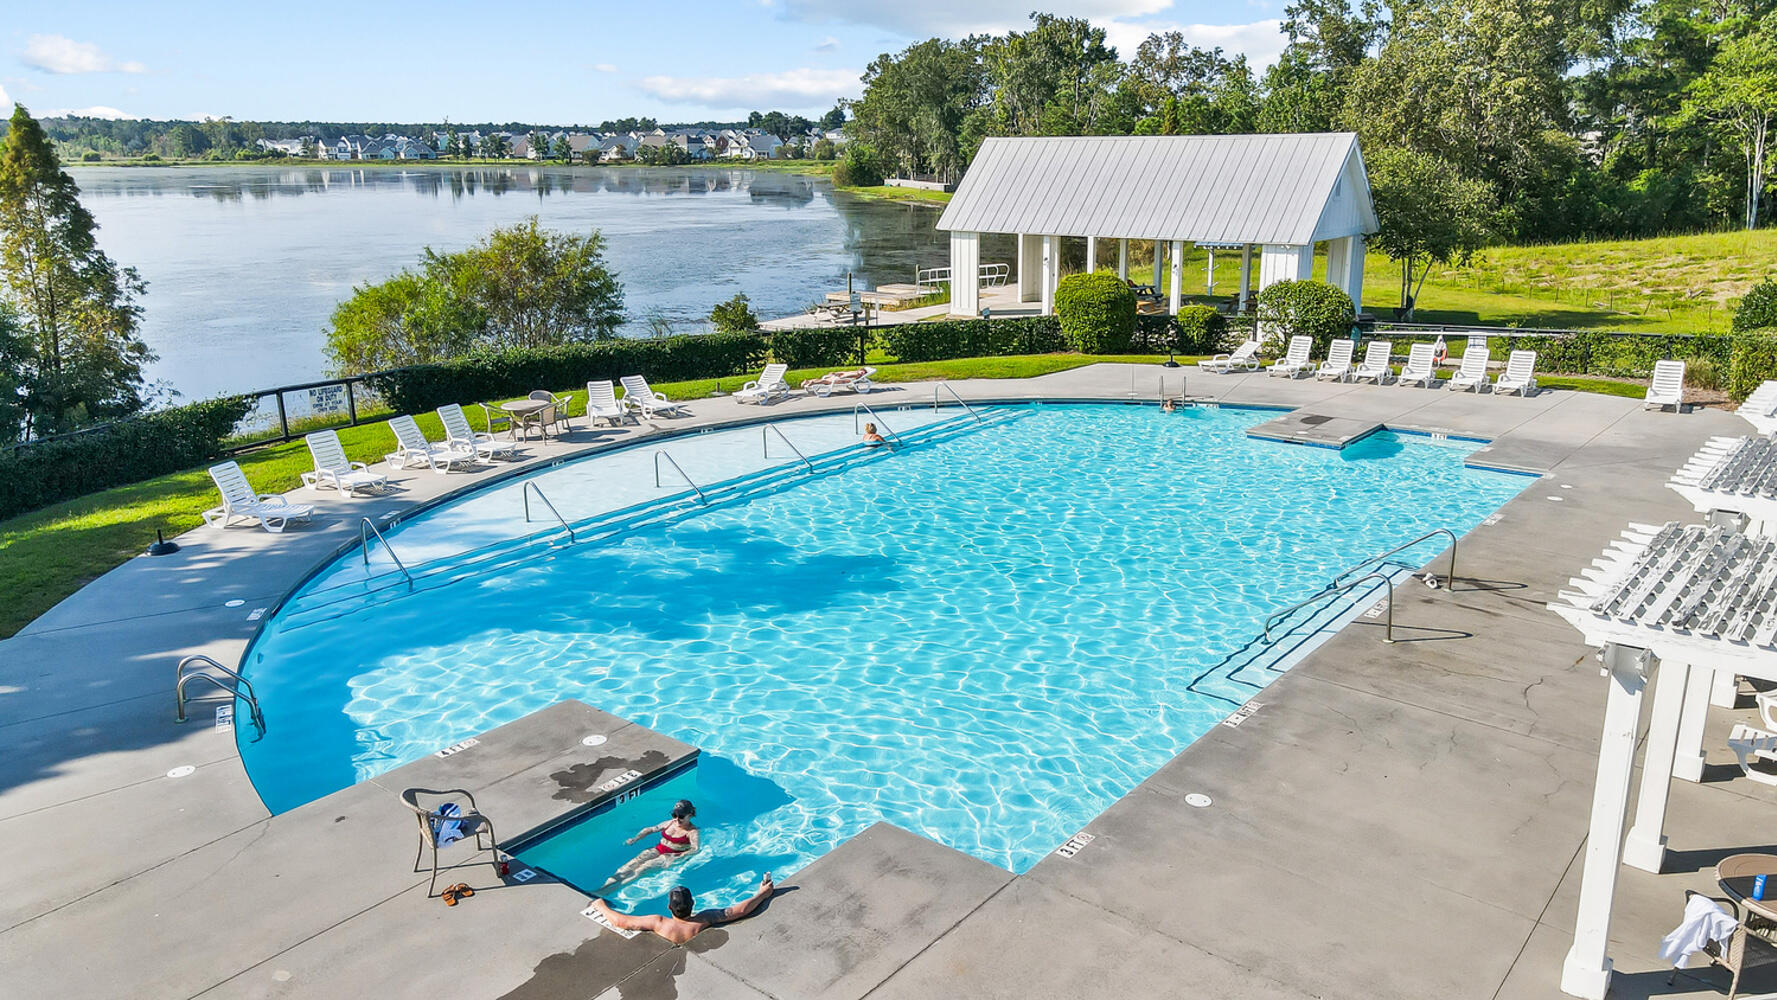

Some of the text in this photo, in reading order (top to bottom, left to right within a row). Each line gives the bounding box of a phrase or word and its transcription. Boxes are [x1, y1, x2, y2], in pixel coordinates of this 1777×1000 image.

[309, 385, 343, 397] NO LIFEGUARD
[325, 393, 338, 401] DUTY
[628, 787, 640, 800] FT
[1060, 839, 1085, 856] 3 FT
